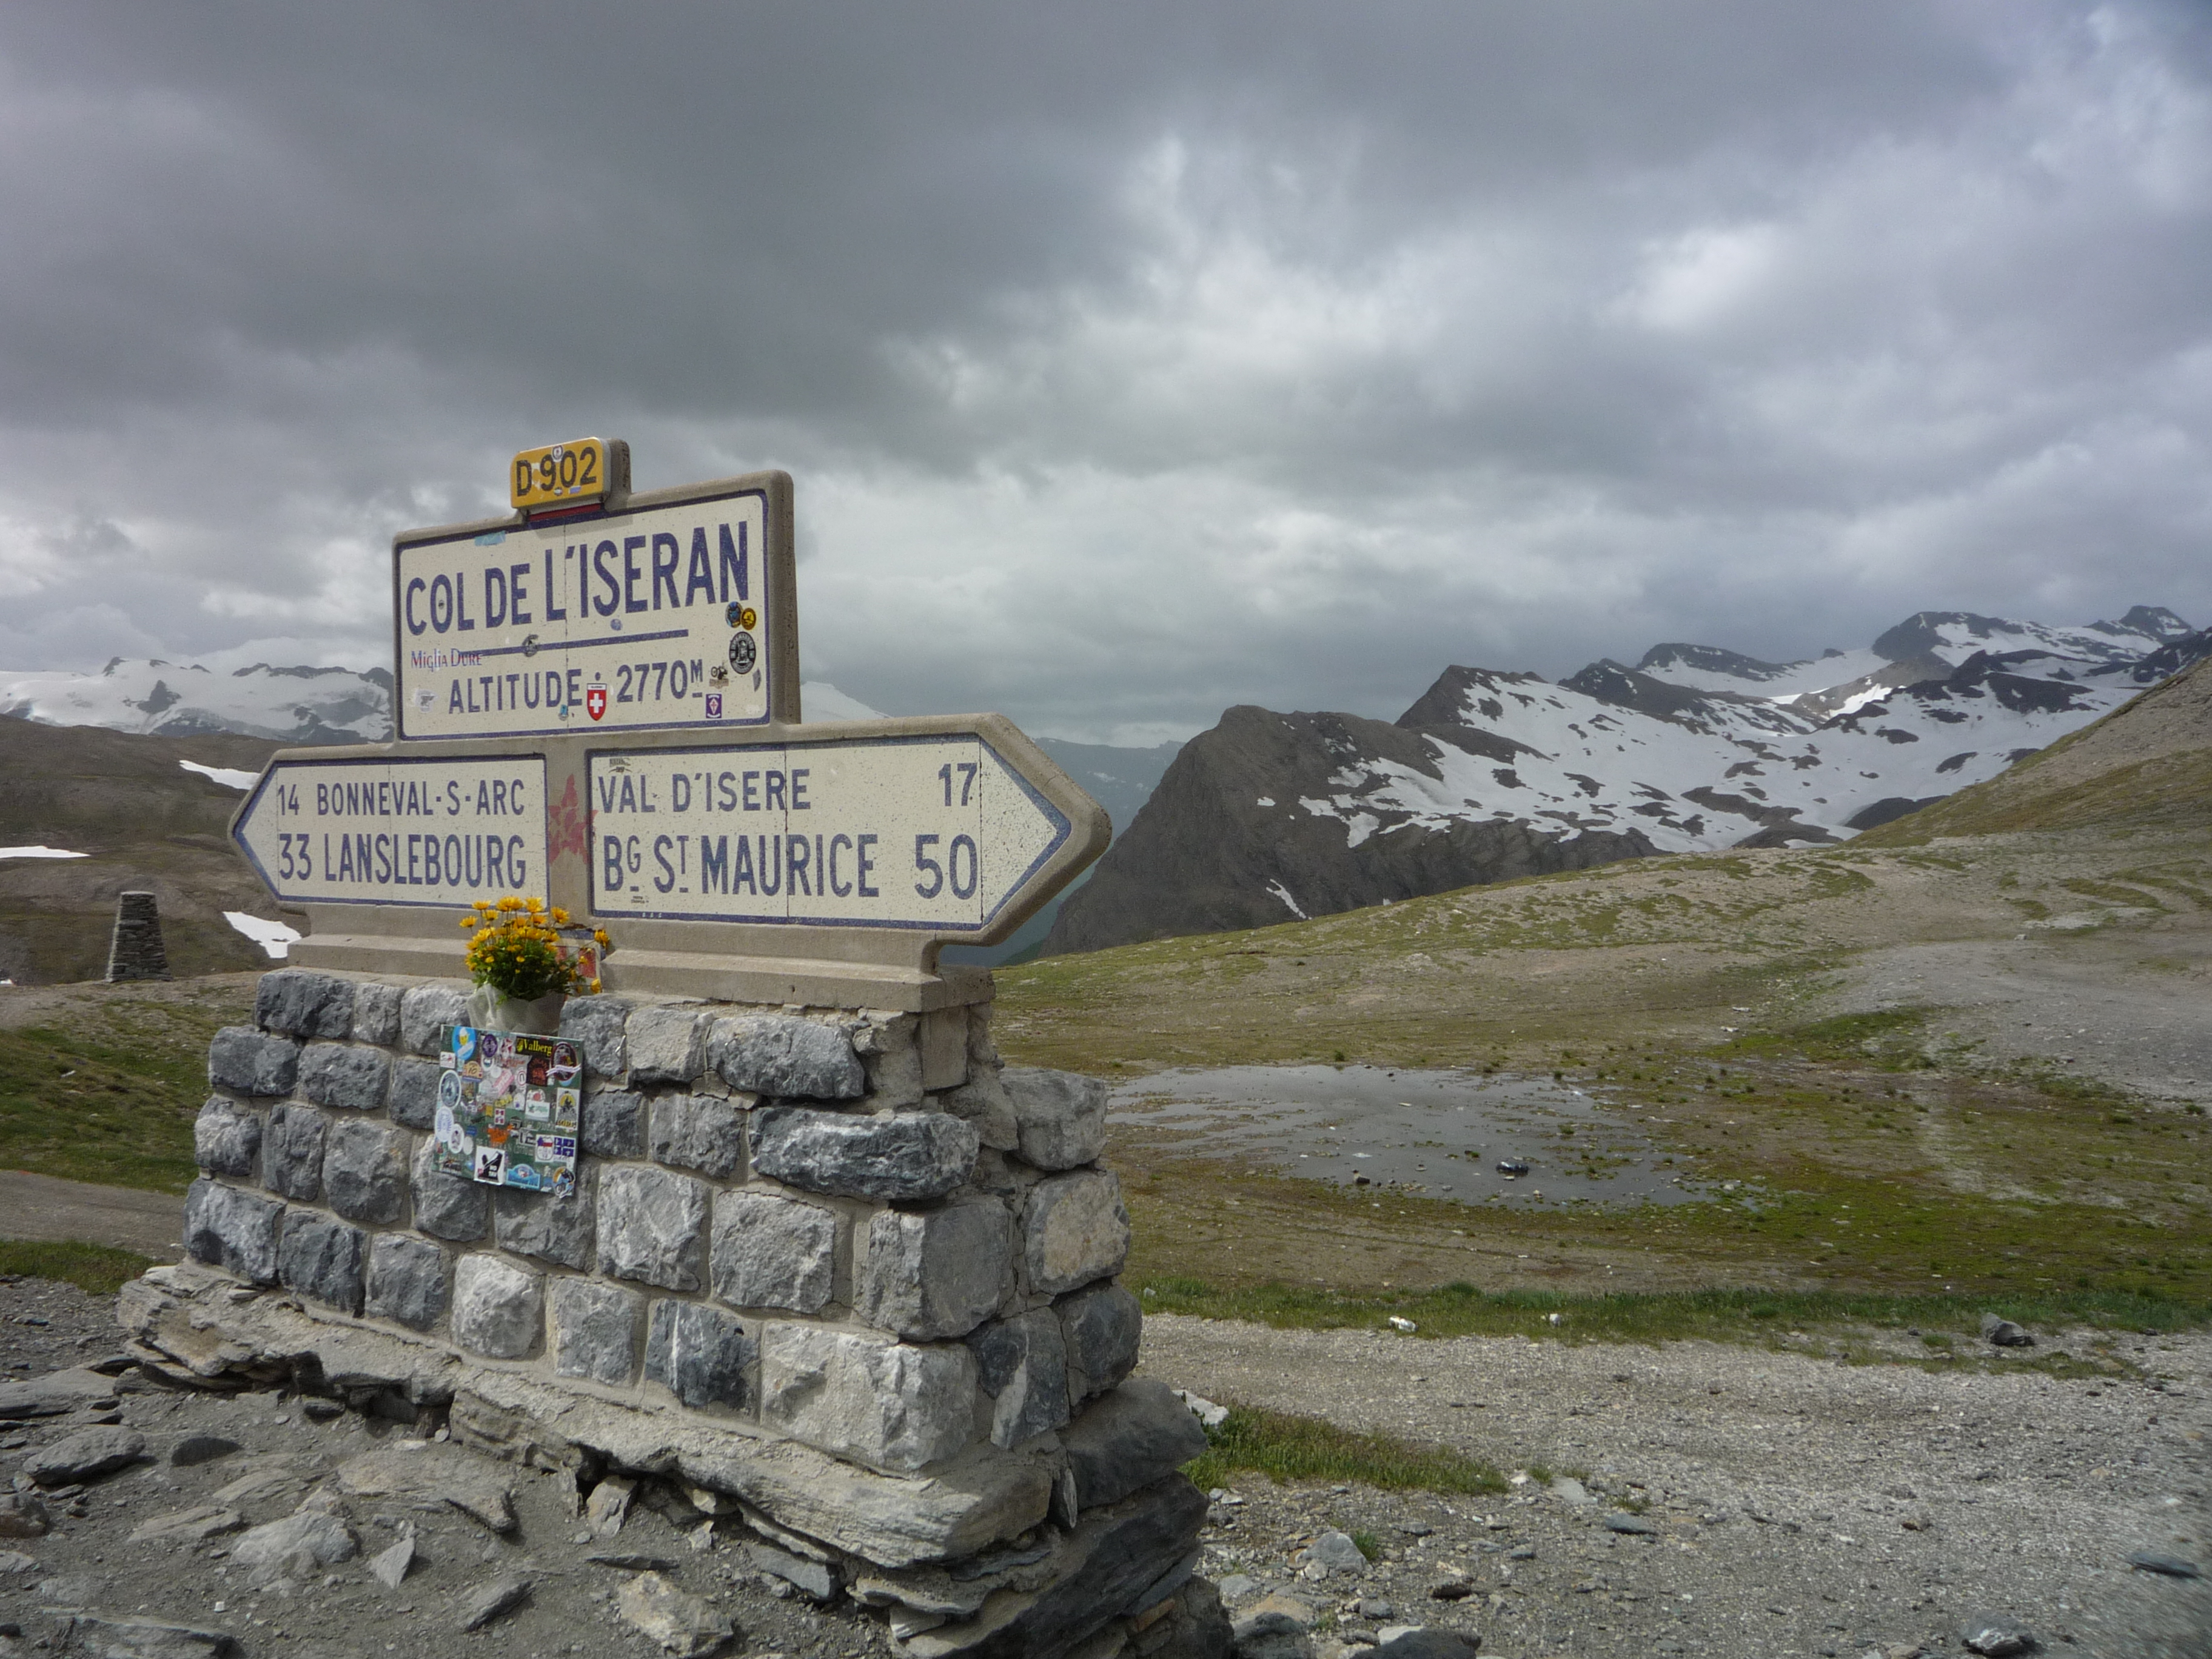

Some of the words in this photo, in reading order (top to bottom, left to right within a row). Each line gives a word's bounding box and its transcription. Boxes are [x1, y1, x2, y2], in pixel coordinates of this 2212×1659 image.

[406, 573, 475, 636] COL
[484, 563, 532, 628] DE
[545, 521, 748, 622] L'ISERAN
[449, 668, 583, 714] ALTITUDE
[277, 784, 300, 816] 14
[598, 774, 656, 813] VAL
[672, 768, 811, 813] D'ISERE
[938, 762, 977, 806] 17
[279, 833, 312, 880] 33
[324, 833, 526, 889] LANSLEBOURG
[700, 834, 880, 898] MAURICE
[914, 834, 977, 900] 50
[524, 1039, 552, 1057] Valberg
